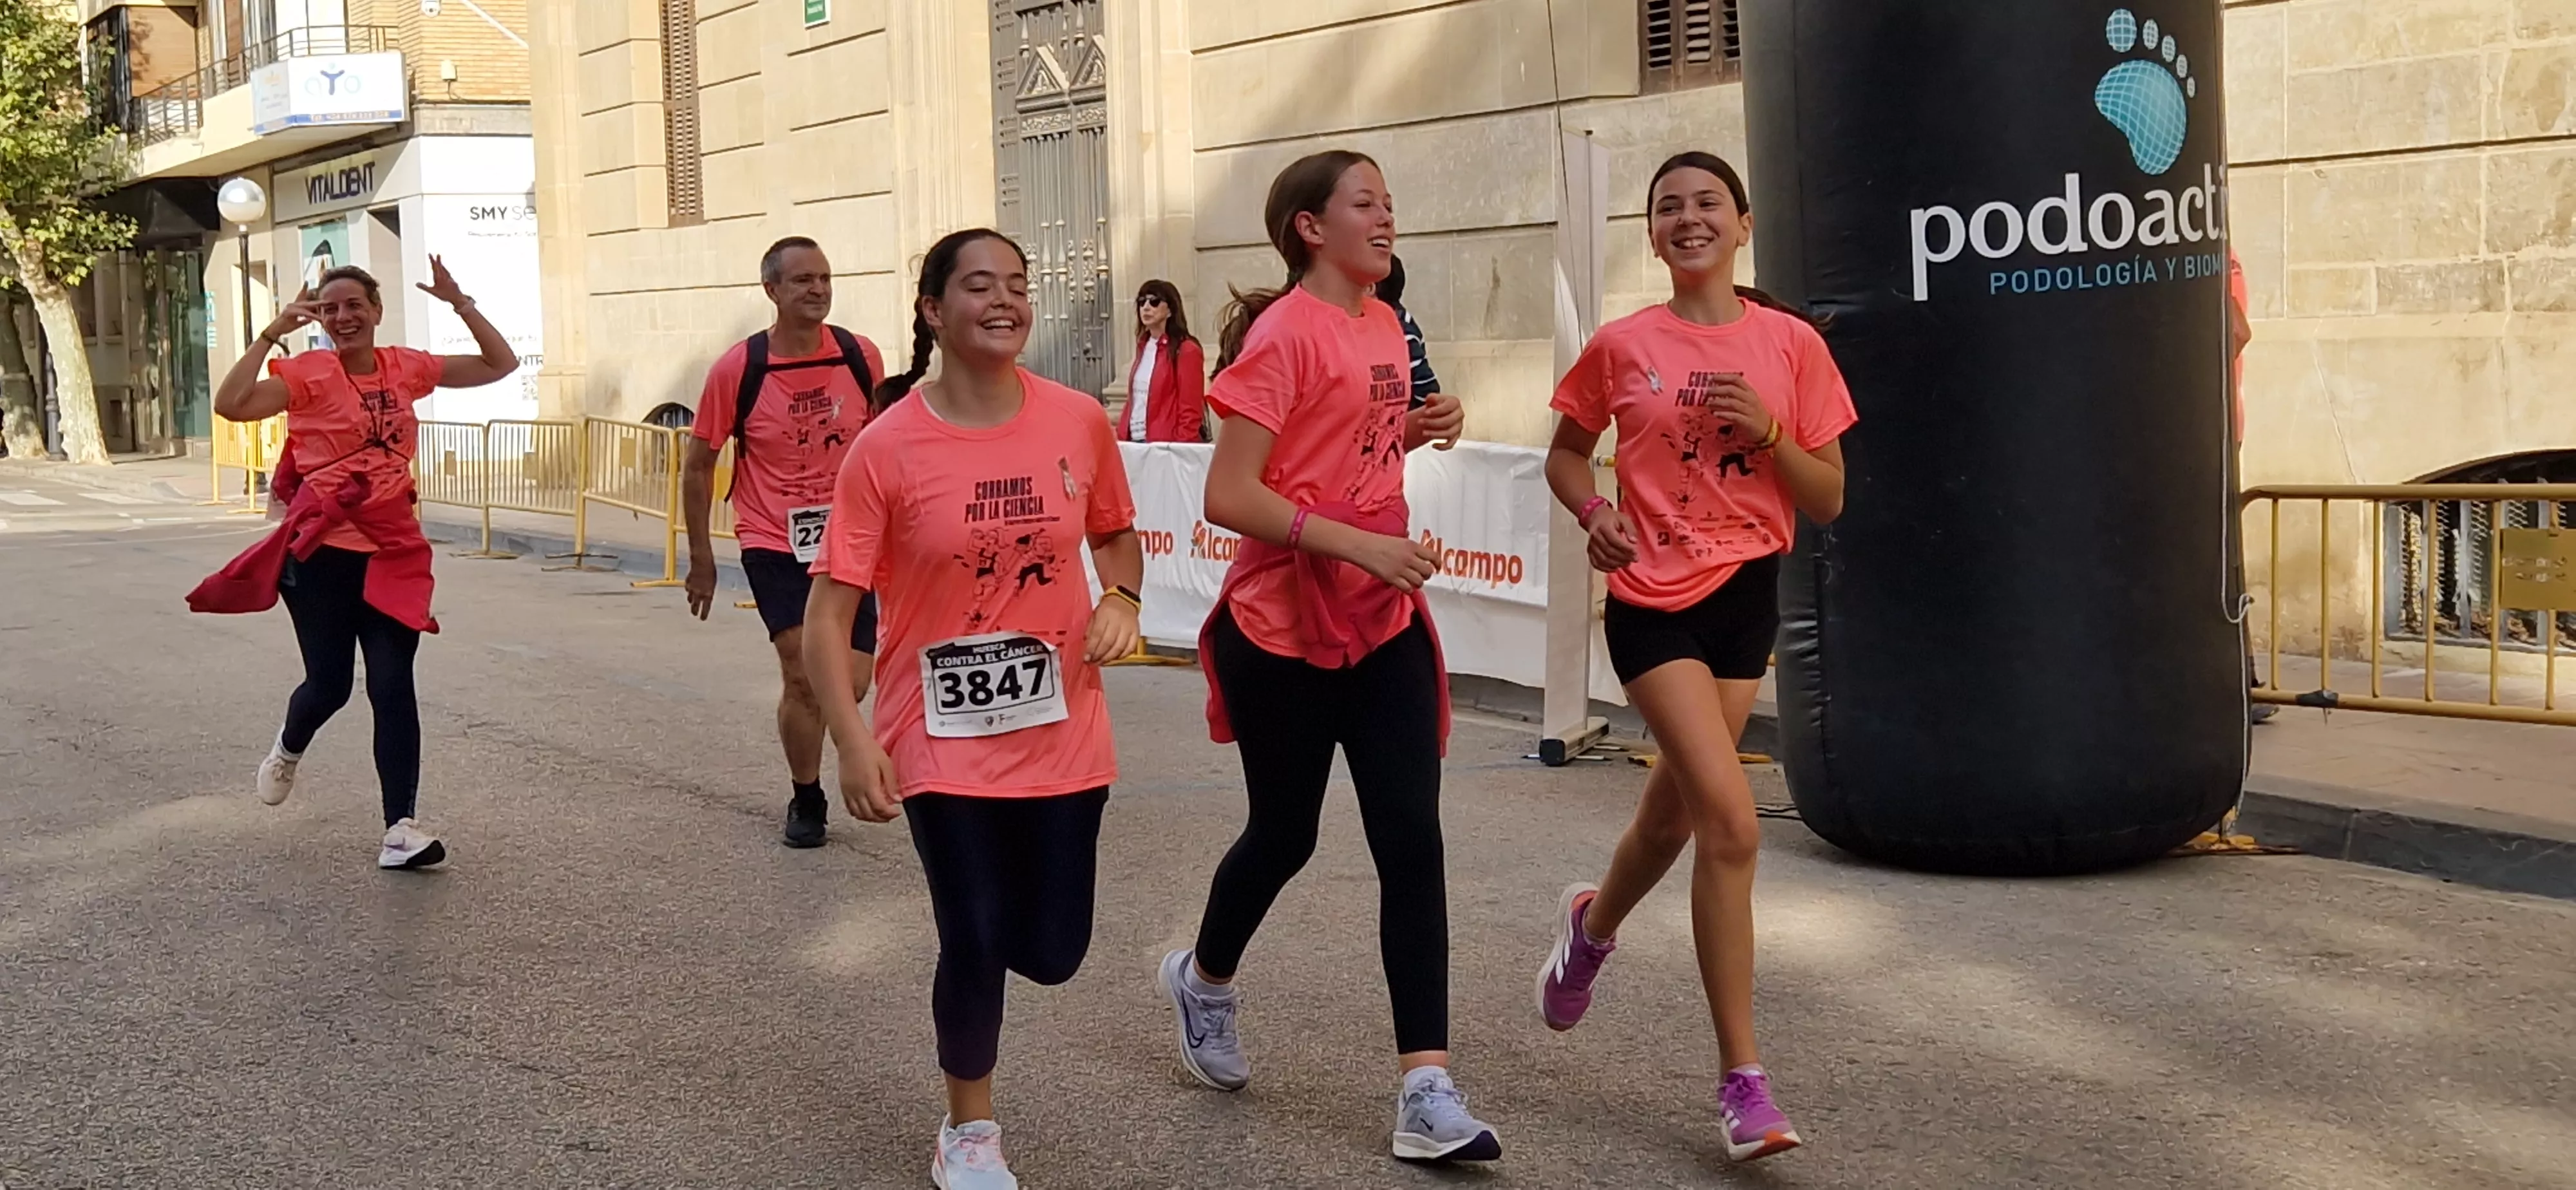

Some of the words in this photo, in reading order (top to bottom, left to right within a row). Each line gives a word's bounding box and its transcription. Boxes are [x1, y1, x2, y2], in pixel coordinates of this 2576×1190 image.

[305, 161, 375, 205] VITALDENT
[470, 205, 507, 220] SMY
[1990, 255, 2157, 295] PODOLOGÍA
[2165, 258, 2178, 279] Y
[974, 477, 1032, 501] CORRAMOS
[965, 504, 985, 523] POR
[989, 500, 999, 520] LA
[1003, 496, 1045, 518] CIENCIA
[936, 653, 983, 667] CONTRA
[985, 653, 998, 663] EL
[1000, 644, 1045, 660] CÁNCER
[938, 658, 1046, 708] 3847
